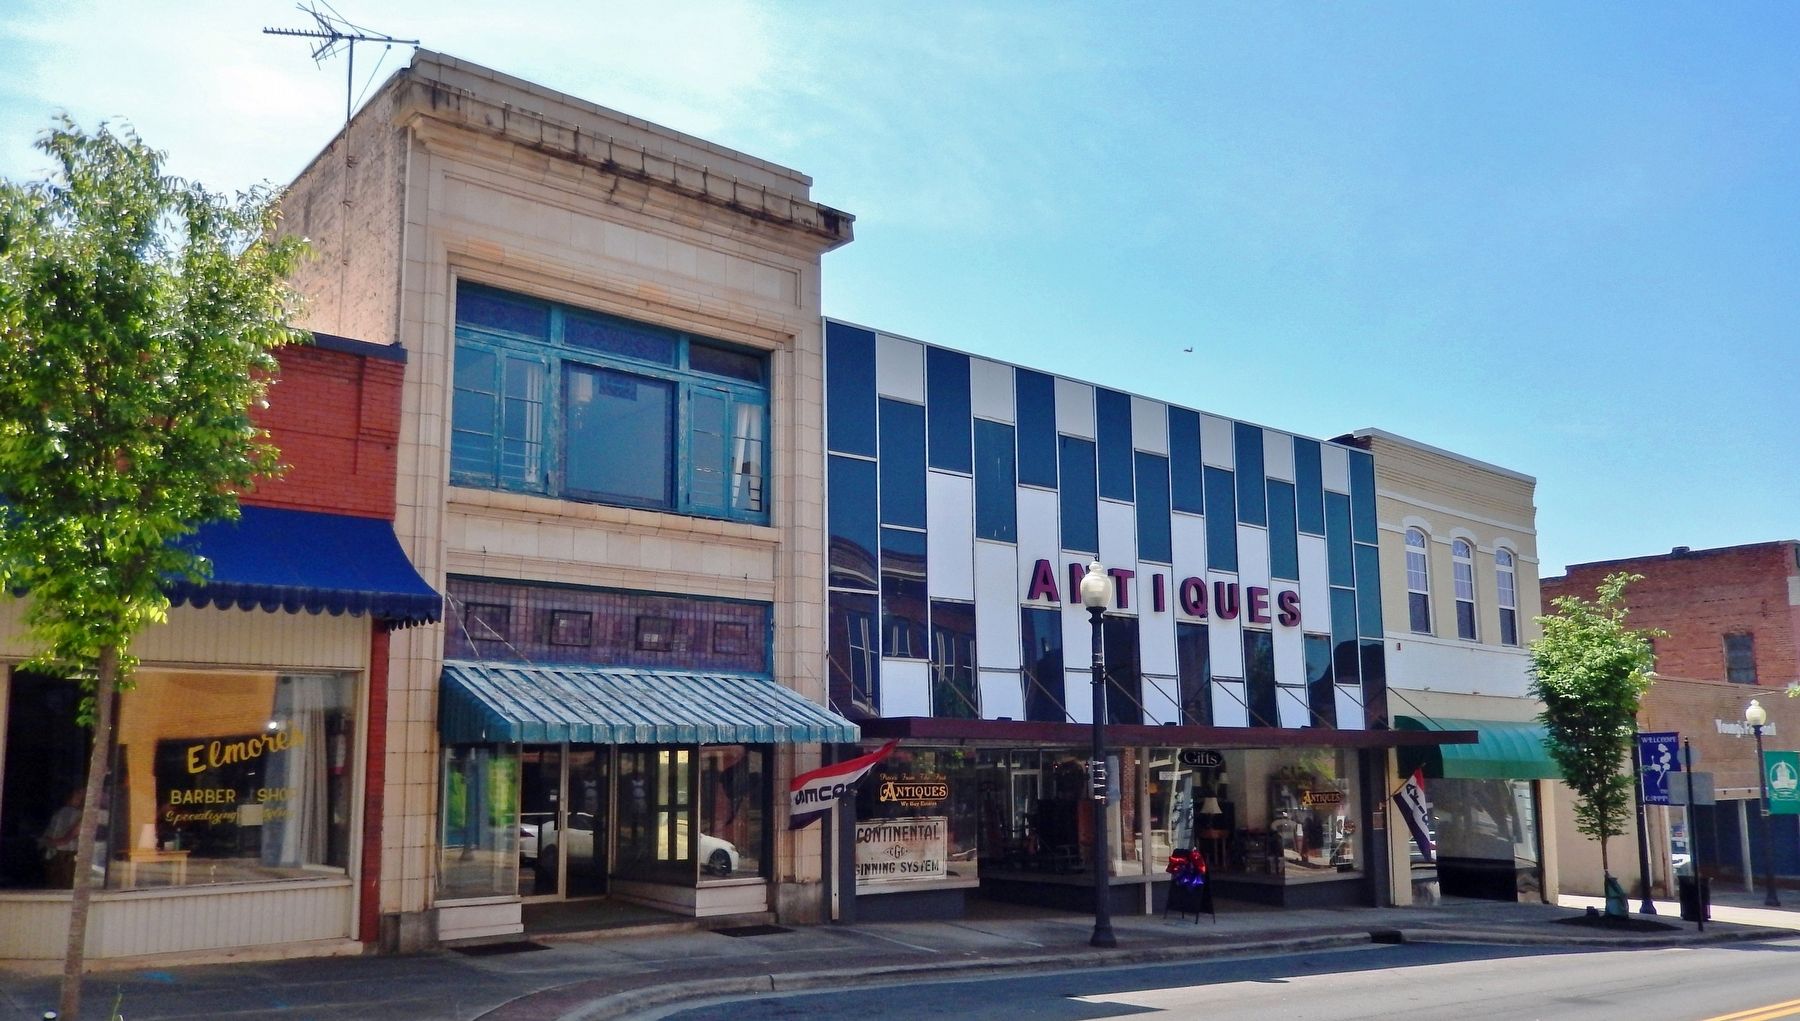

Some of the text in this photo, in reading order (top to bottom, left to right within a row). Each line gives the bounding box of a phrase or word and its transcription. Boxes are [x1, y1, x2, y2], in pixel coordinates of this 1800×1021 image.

[1184, 752, 1218, 764] Gifts
[170, 788, 296, 804] BARBER SHOP
[881, 782, 946, 801] ANTIQUES
[857, 825, 940, 843] CONTINENTAL
[901, 860, 939, 873] SYSTEM
